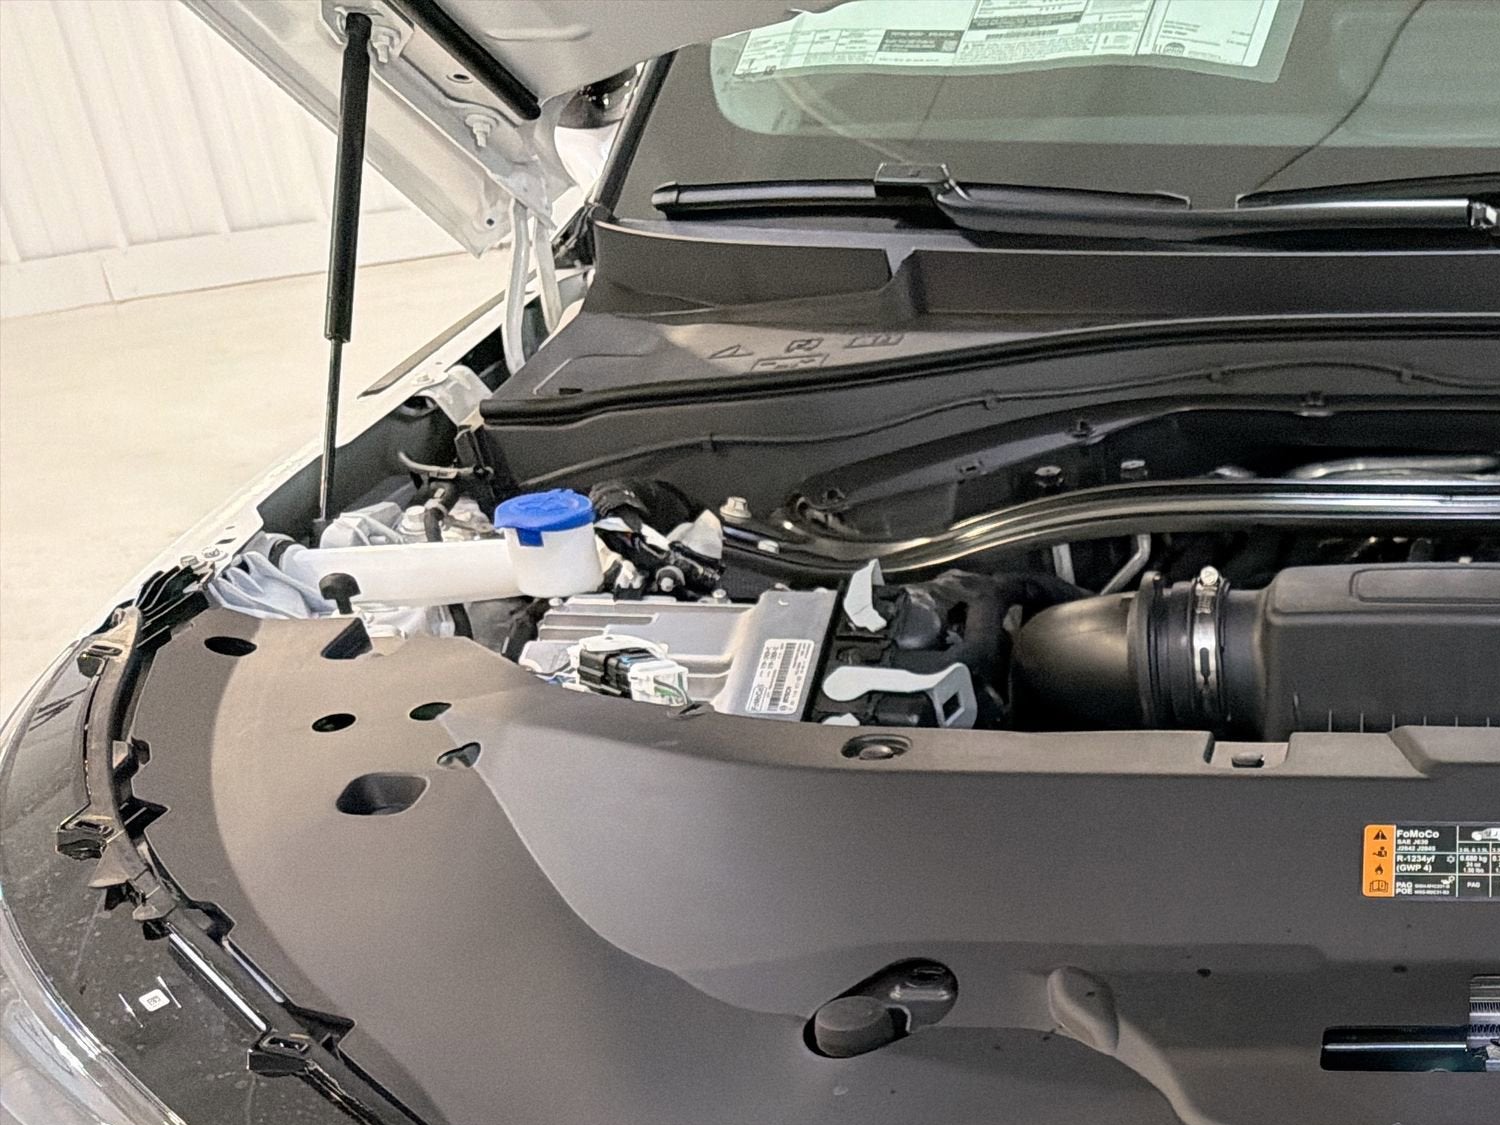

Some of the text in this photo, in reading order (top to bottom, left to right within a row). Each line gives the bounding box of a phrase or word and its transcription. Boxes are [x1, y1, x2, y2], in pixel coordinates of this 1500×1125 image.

[1396, 829, 1440, 839] FoMoCo
[1396, 855, 1436, 864] R-1234yf
[1396, 864, 1433, 873] (GWP 4)
